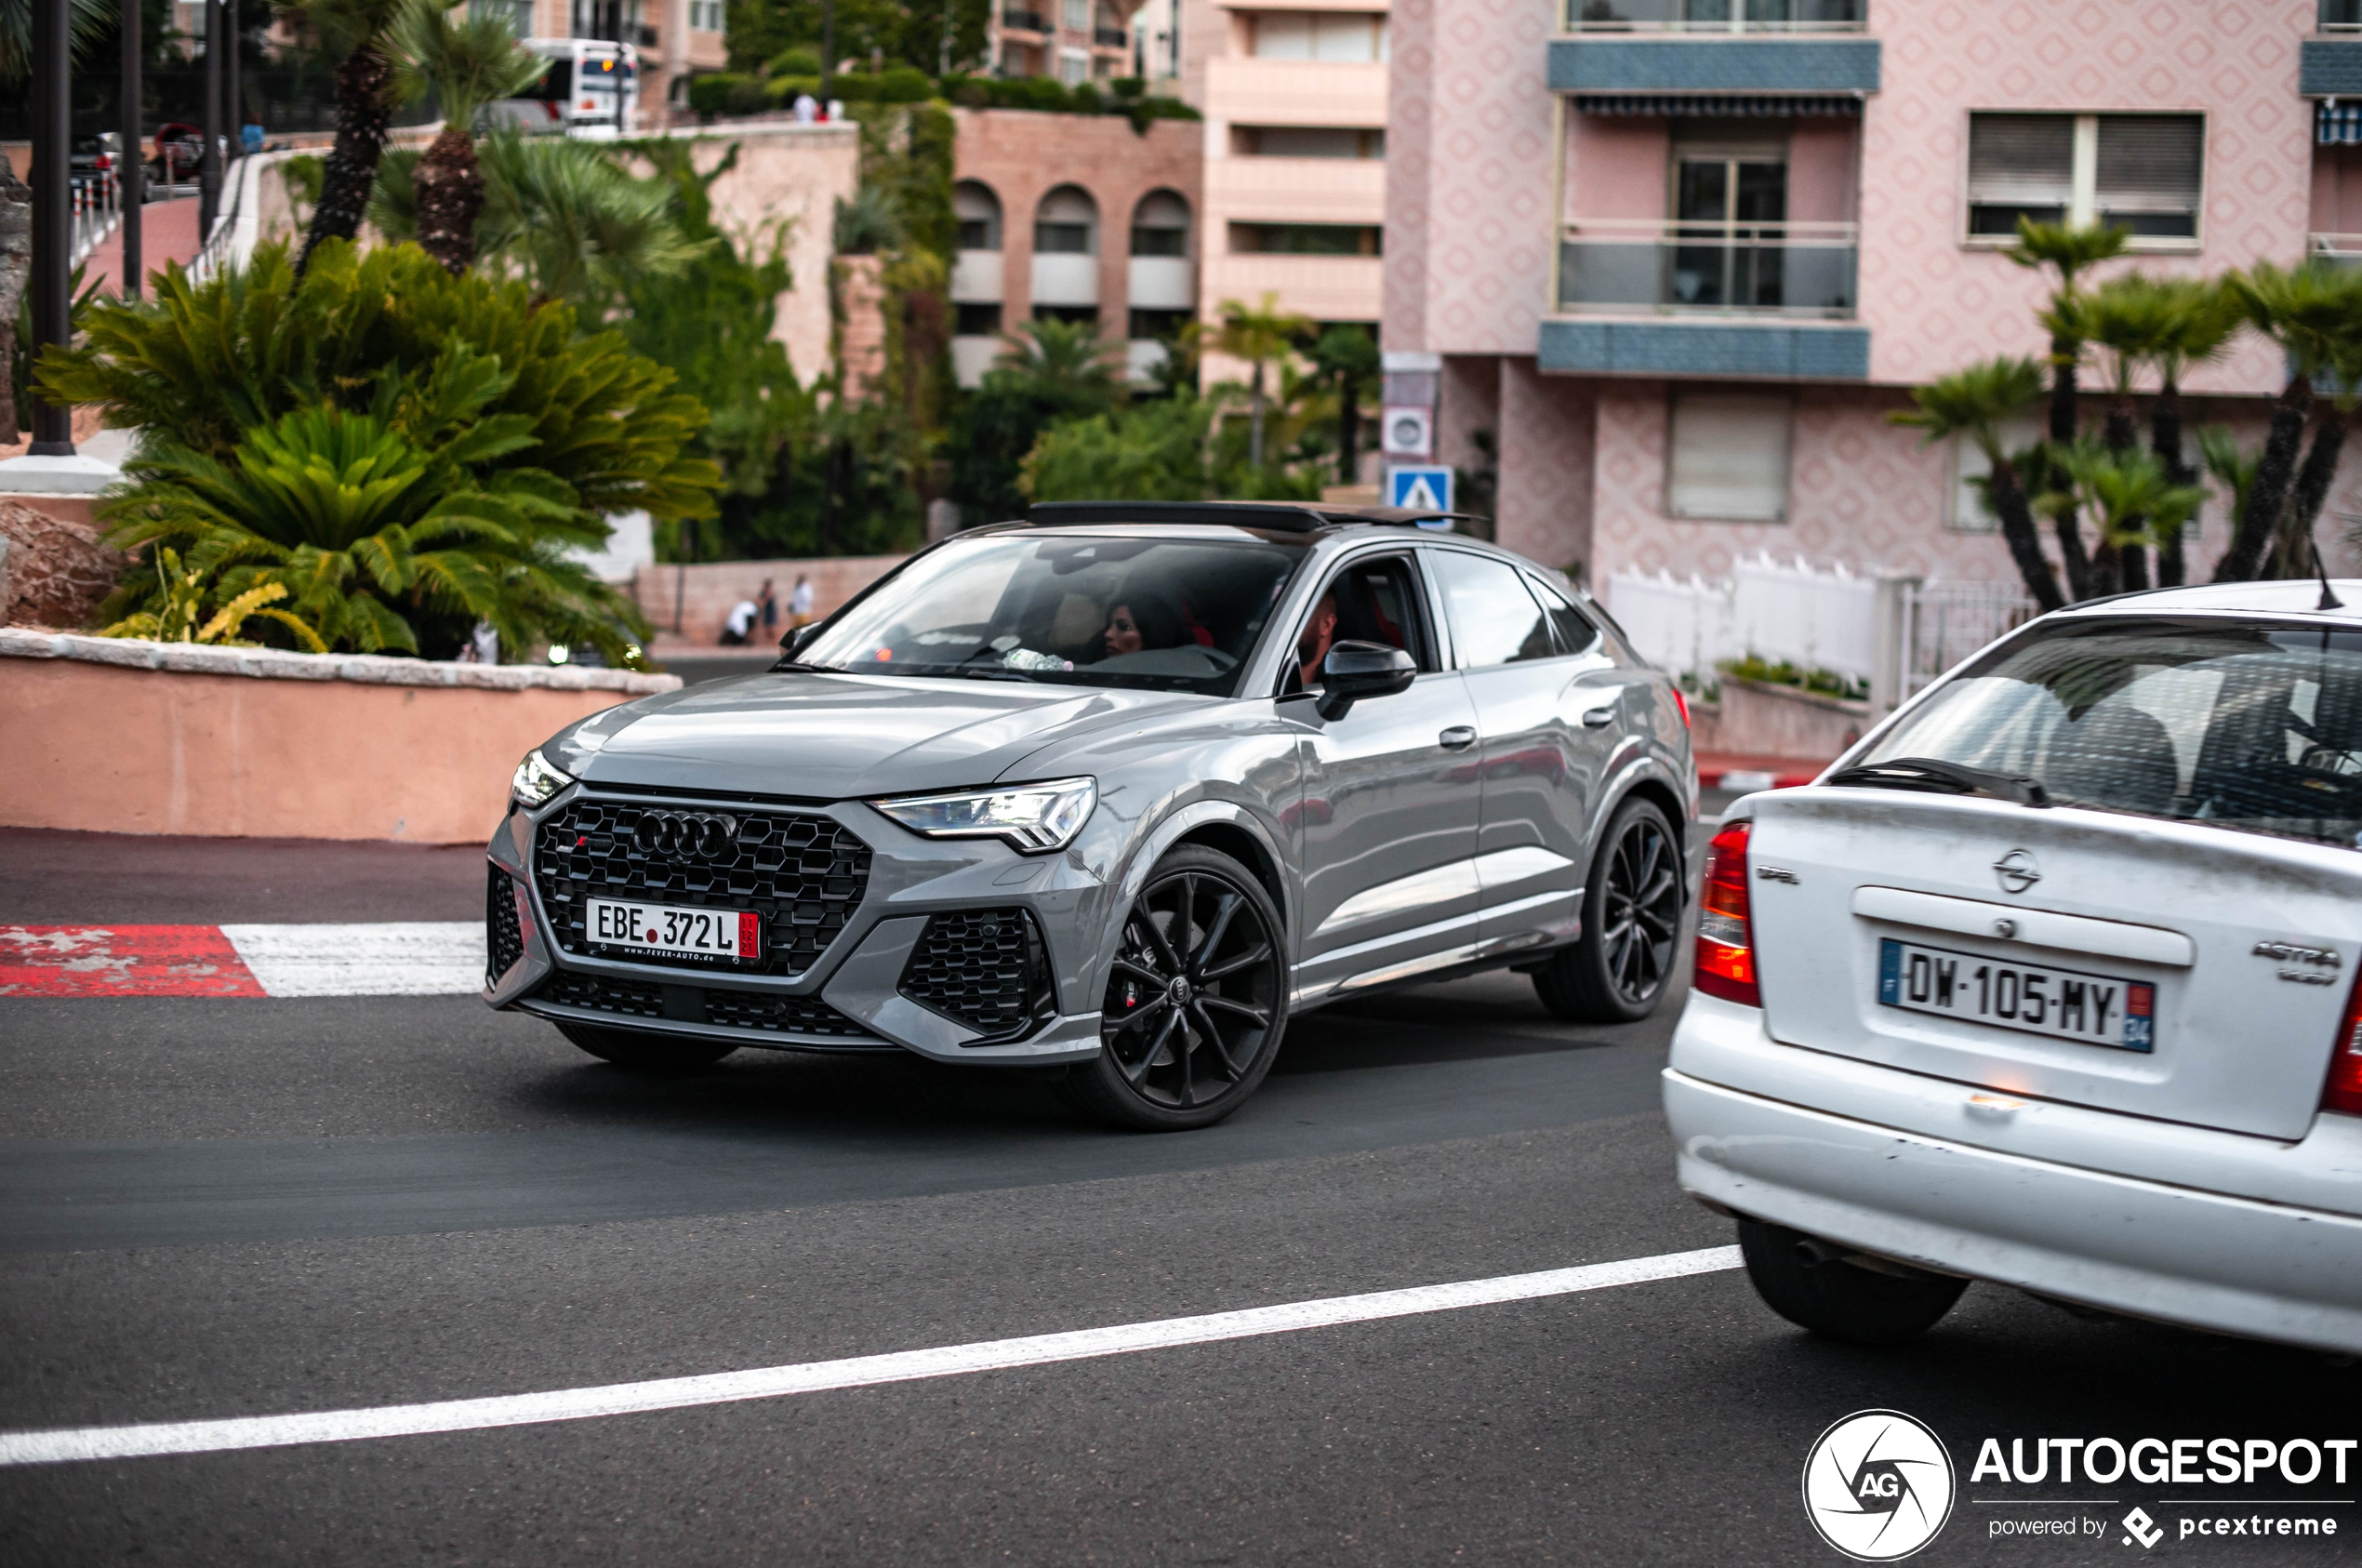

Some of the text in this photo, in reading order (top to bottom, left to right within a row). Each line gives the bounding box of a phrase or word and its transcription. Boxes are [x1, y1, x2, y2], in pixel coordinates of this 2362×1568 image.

[598, 905, 644, 942] EBE
[741, 918, 752, 928] 11
[741, 929, 753, 940] 12
[741, 941, 752, 952] 21
[624, 947, 714, 962] www.FEVER-AUTO.de
[2251, 941, 2342, 968] ASTRA
[1883, 978, 1896, 992] F
[1908, 952, 2117, 1035] DW-105-MY
[2123, 1018, 2151, 1043] 34
